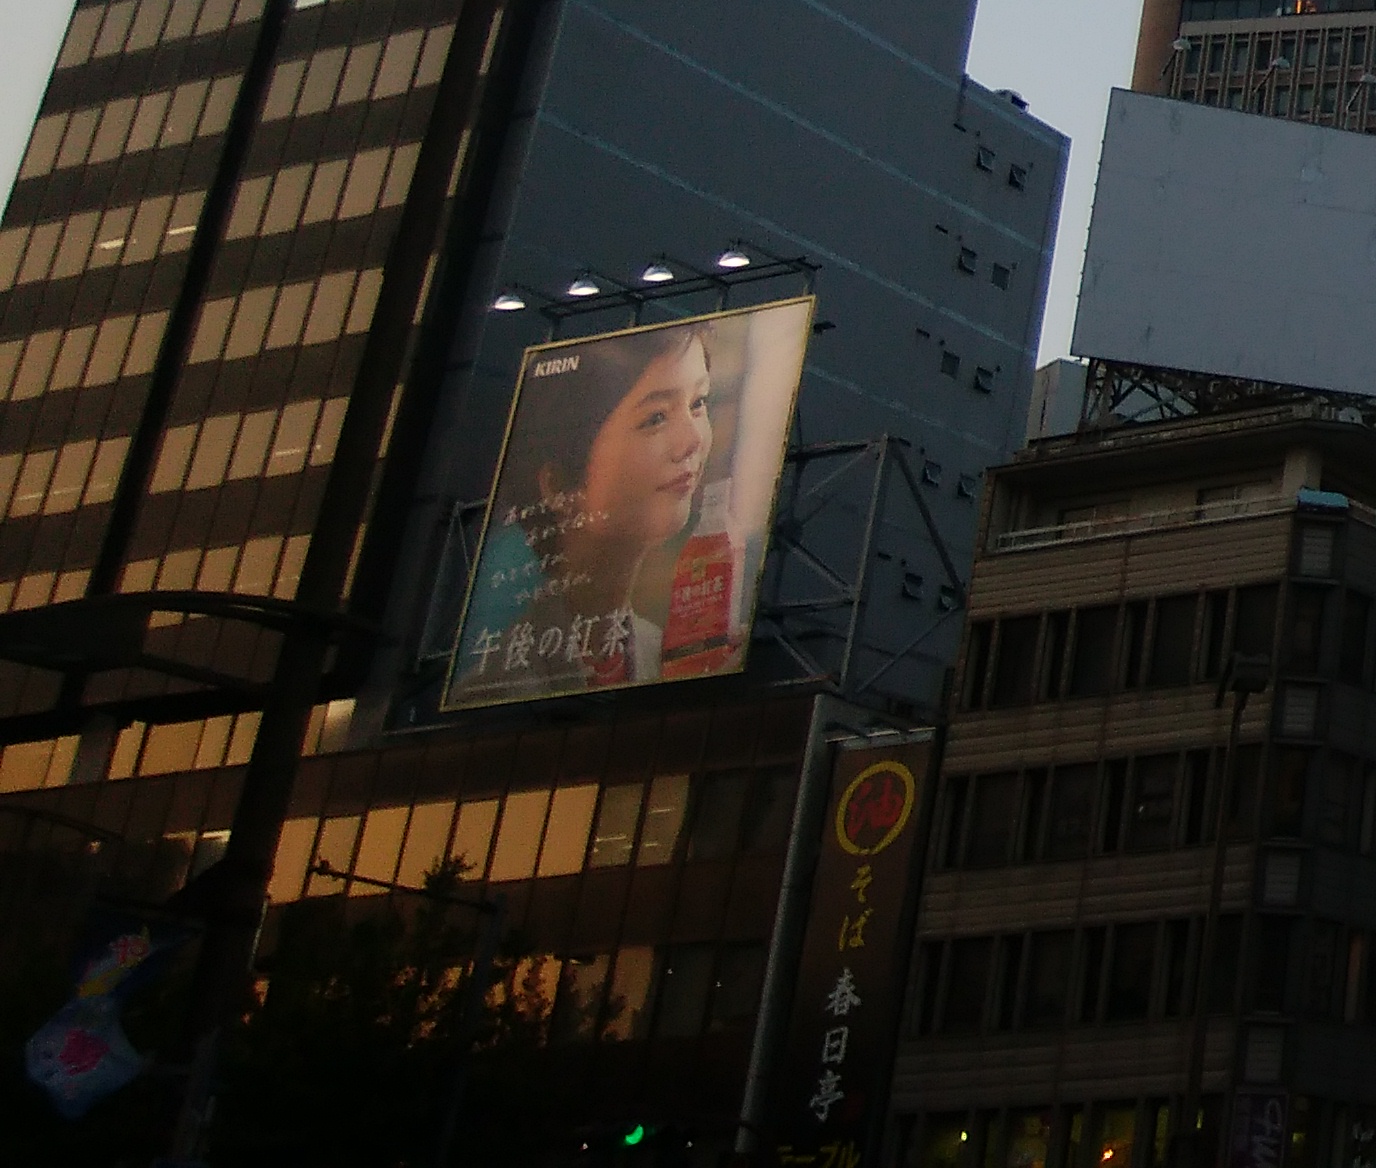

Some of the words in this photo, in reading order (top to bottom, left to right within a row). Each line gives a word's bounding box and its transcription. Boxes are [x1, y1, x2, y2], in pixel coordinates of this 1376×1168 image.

[534, 355, 580, 377] KIRIN
[471, 607, 633, 675] 午後の紅茶
[808, 967, 863, 1122] 春日亭
